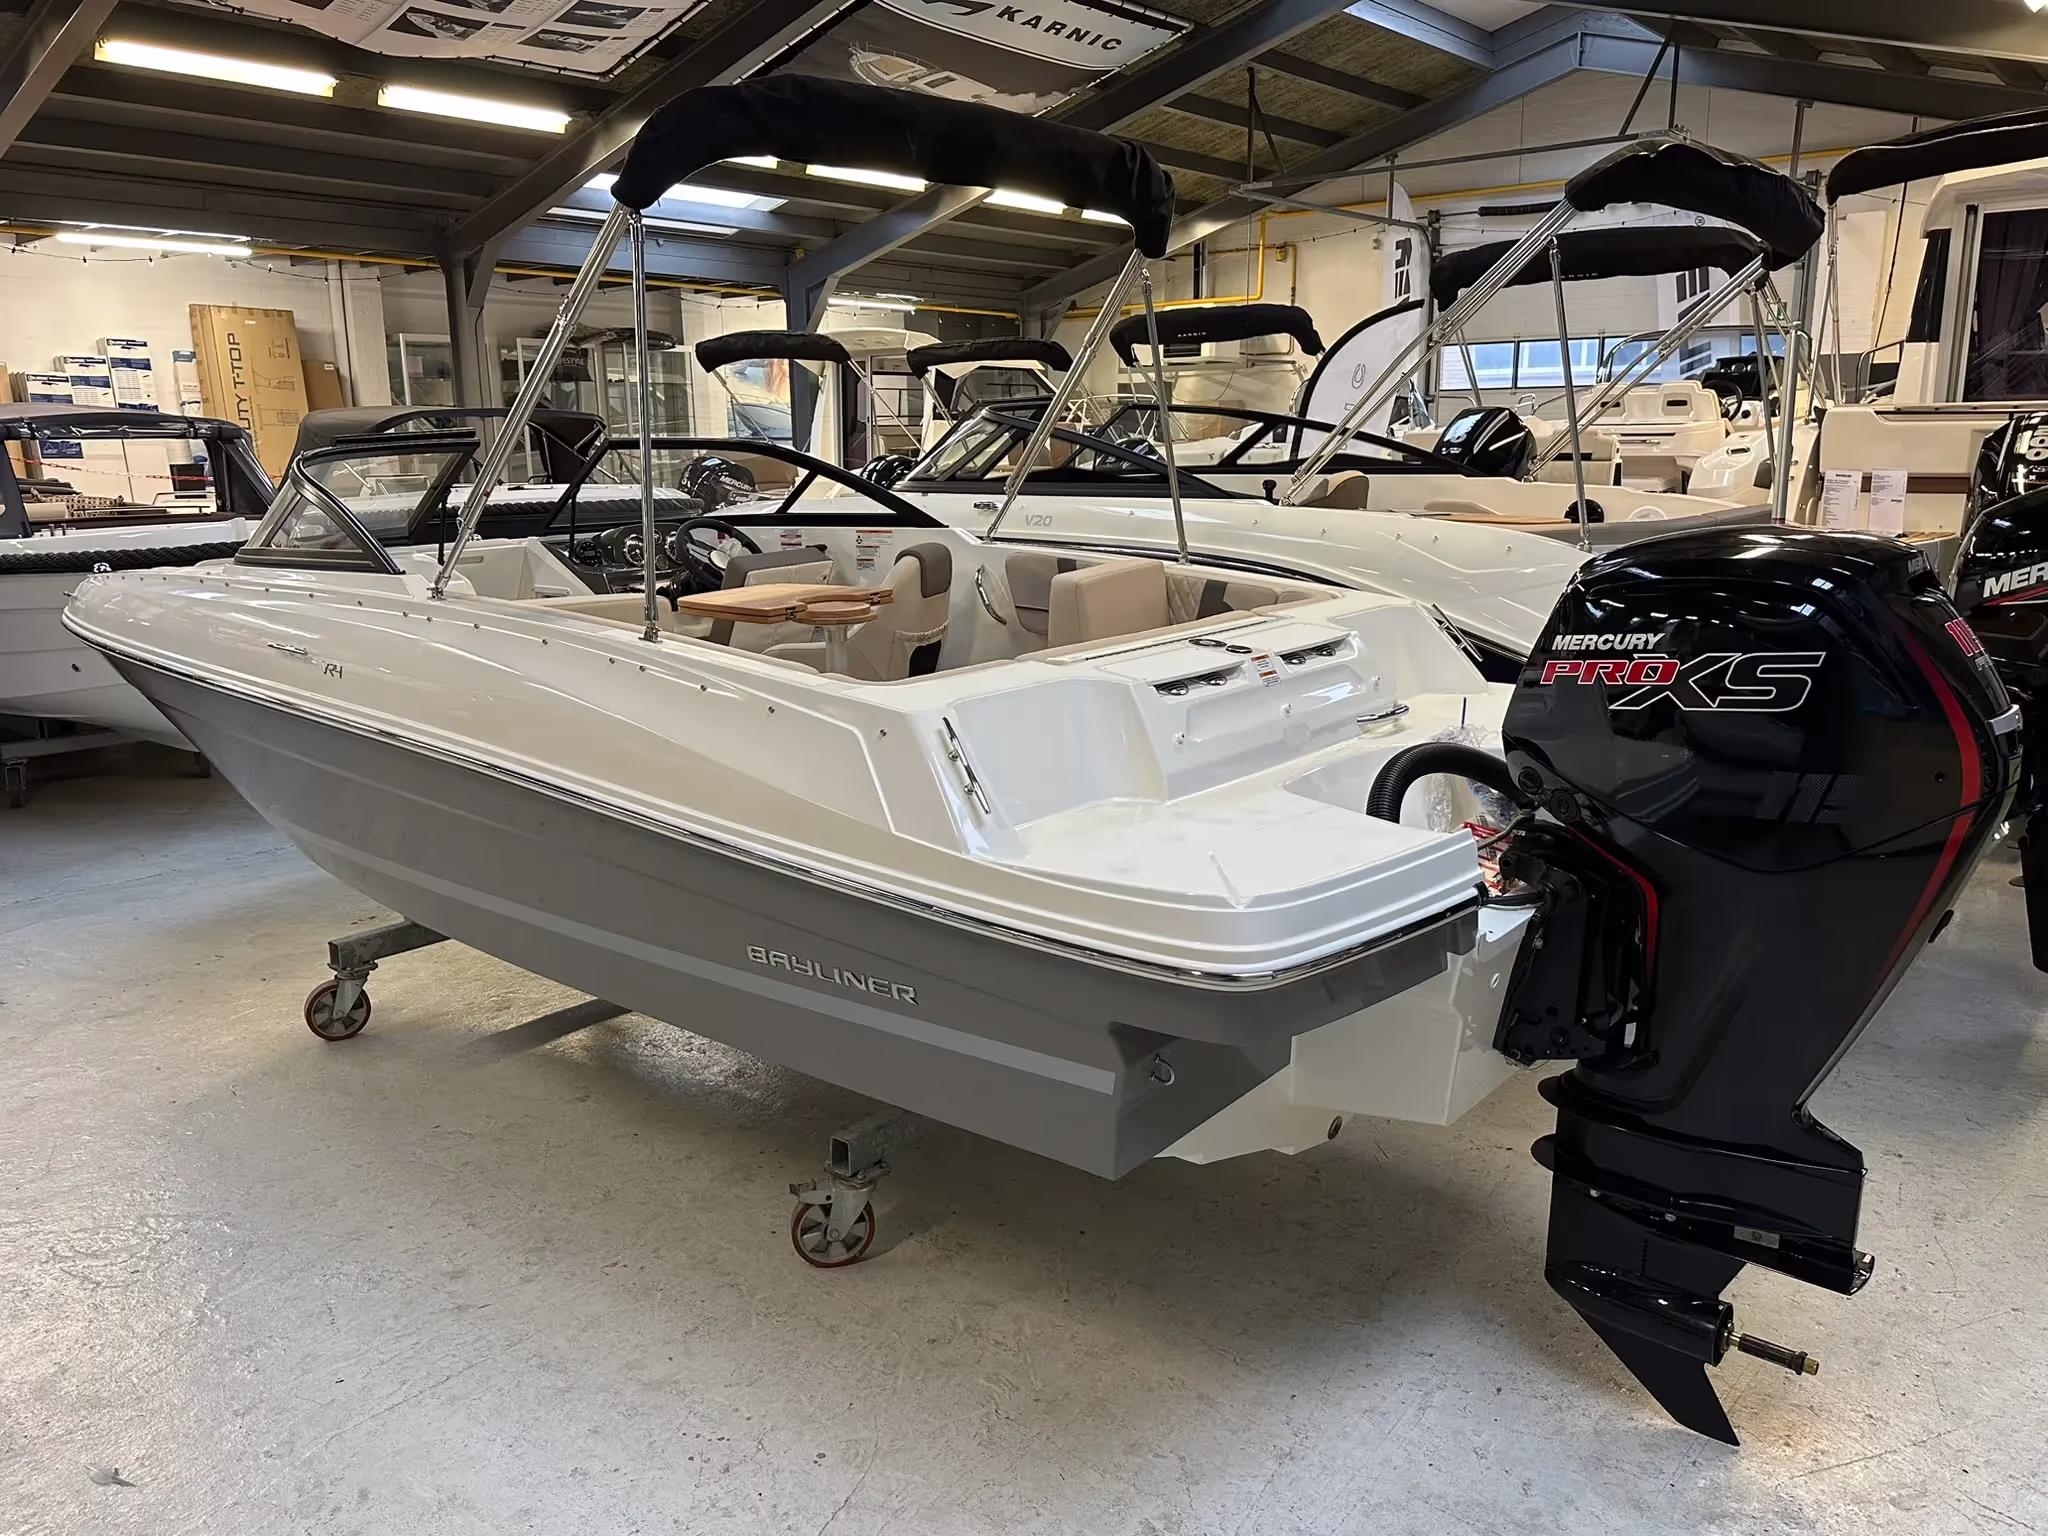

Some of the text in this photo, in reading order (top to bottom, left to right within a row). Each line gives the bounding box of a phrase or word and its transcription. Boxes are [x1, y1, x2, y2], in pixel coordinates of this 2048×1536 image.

[996, 5, 1123, 51] KARNIC
[227, 333, 245, 389] T-TOP
[719, 475, 753, 492] MERCURY
[1025, 514, 1053, 527] V20
[1552, 633, 1665, 650] MERCURY
[747, 944, 919, 1005] BAYLINER
